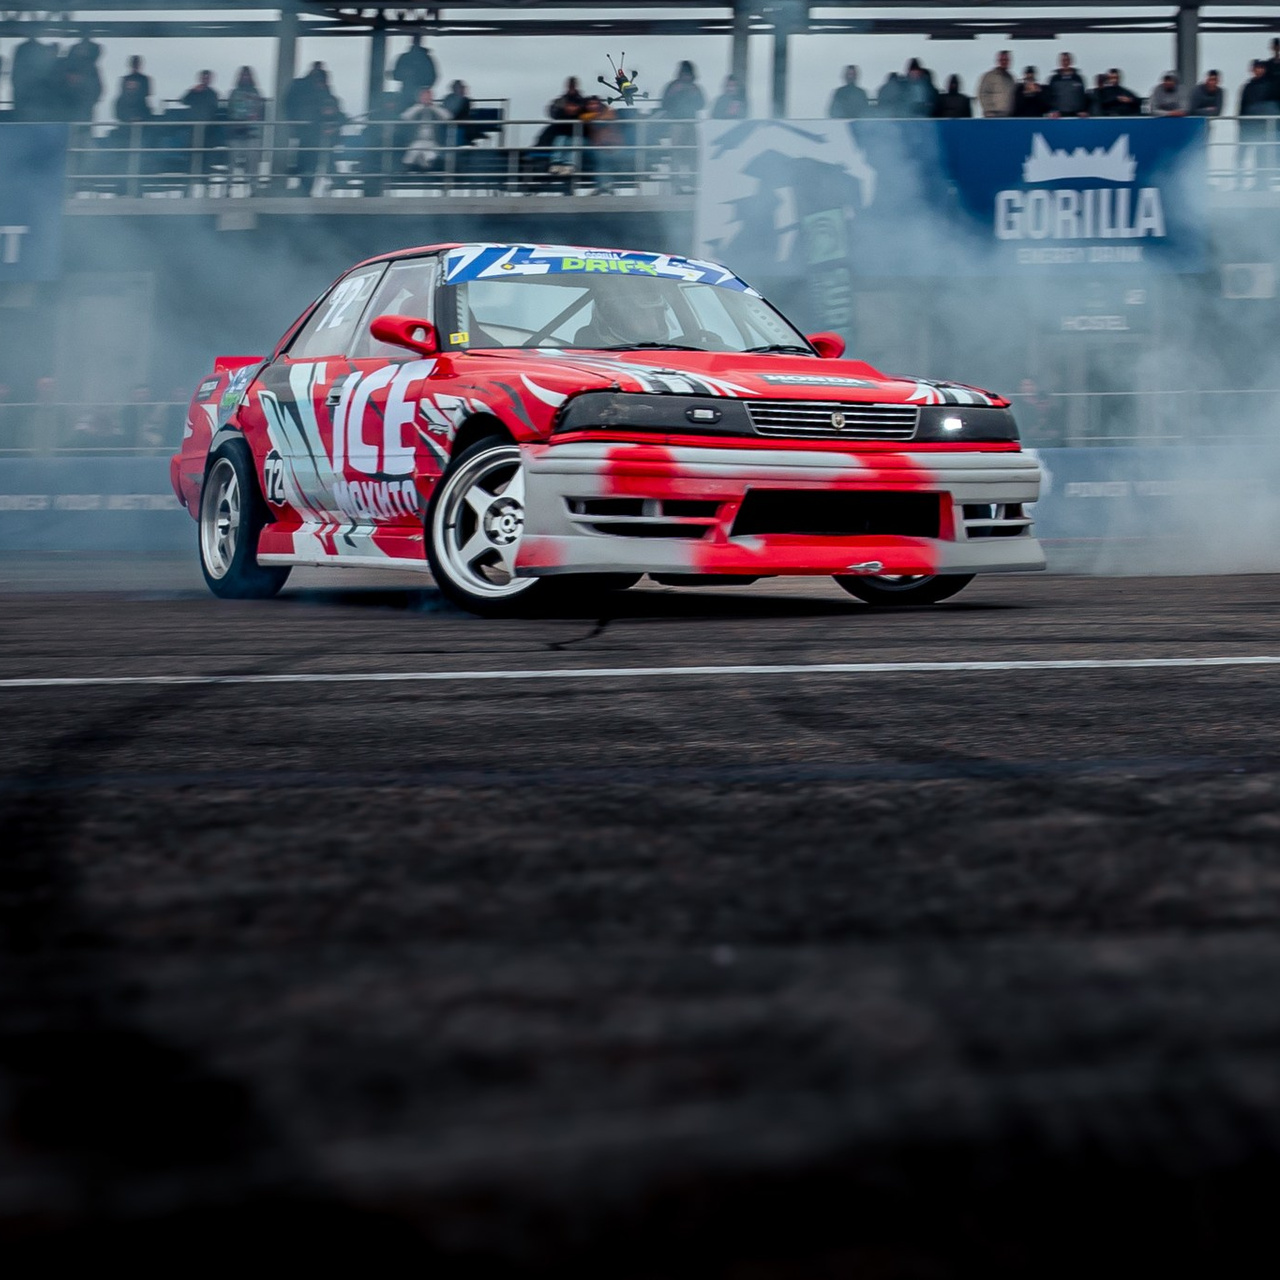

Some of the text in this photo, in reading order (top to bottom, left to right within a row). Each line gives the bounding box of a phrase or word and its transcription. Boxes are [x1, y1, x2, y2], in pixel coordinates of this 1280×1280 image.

[994, 187, 1167, 240] GORILLA
[562, 257, 658, 276] DRIFT
[265, 459, 285, 501] 72
